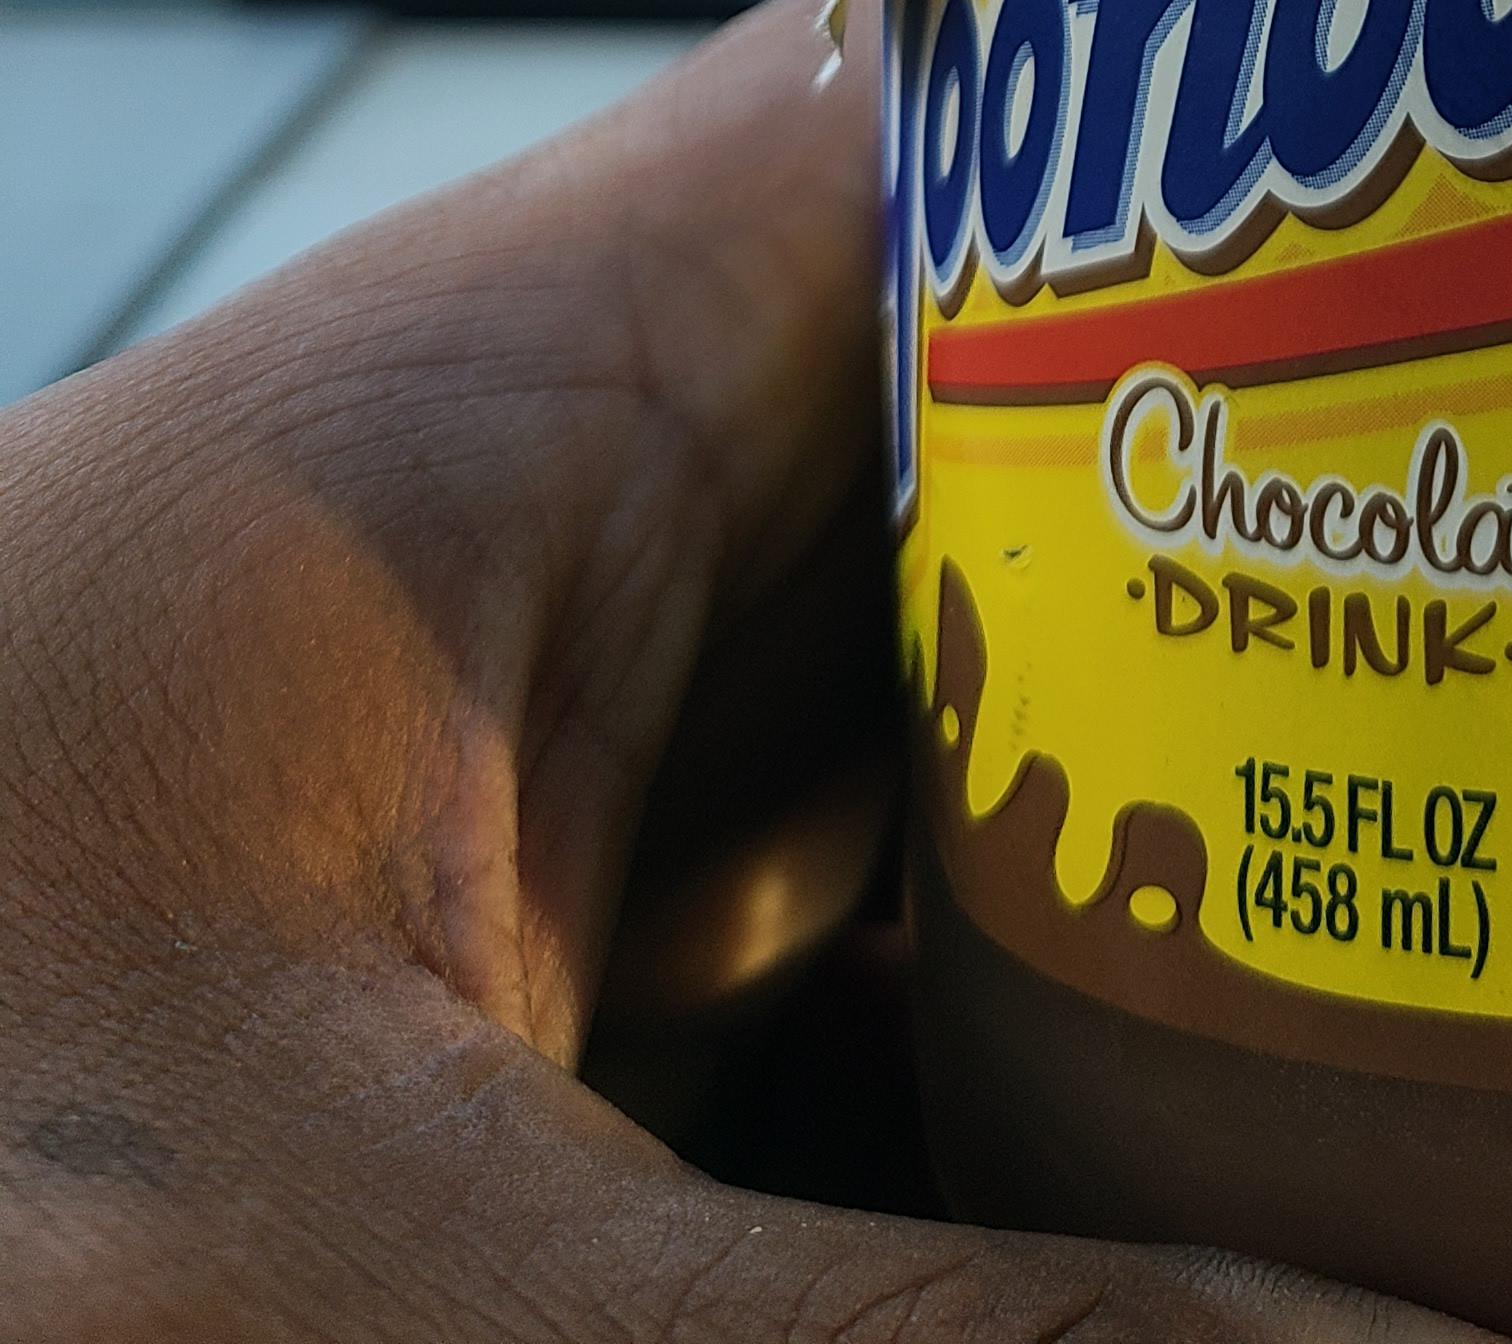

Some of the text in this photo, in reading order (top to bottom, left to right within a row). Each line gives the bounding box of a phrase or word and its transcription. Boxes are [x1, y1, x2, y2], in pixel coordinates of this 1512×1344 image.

[1235, 755, 1498, 872] 15.5 FL OZ
[1237, 846, 1491, 980] (458 mL)
